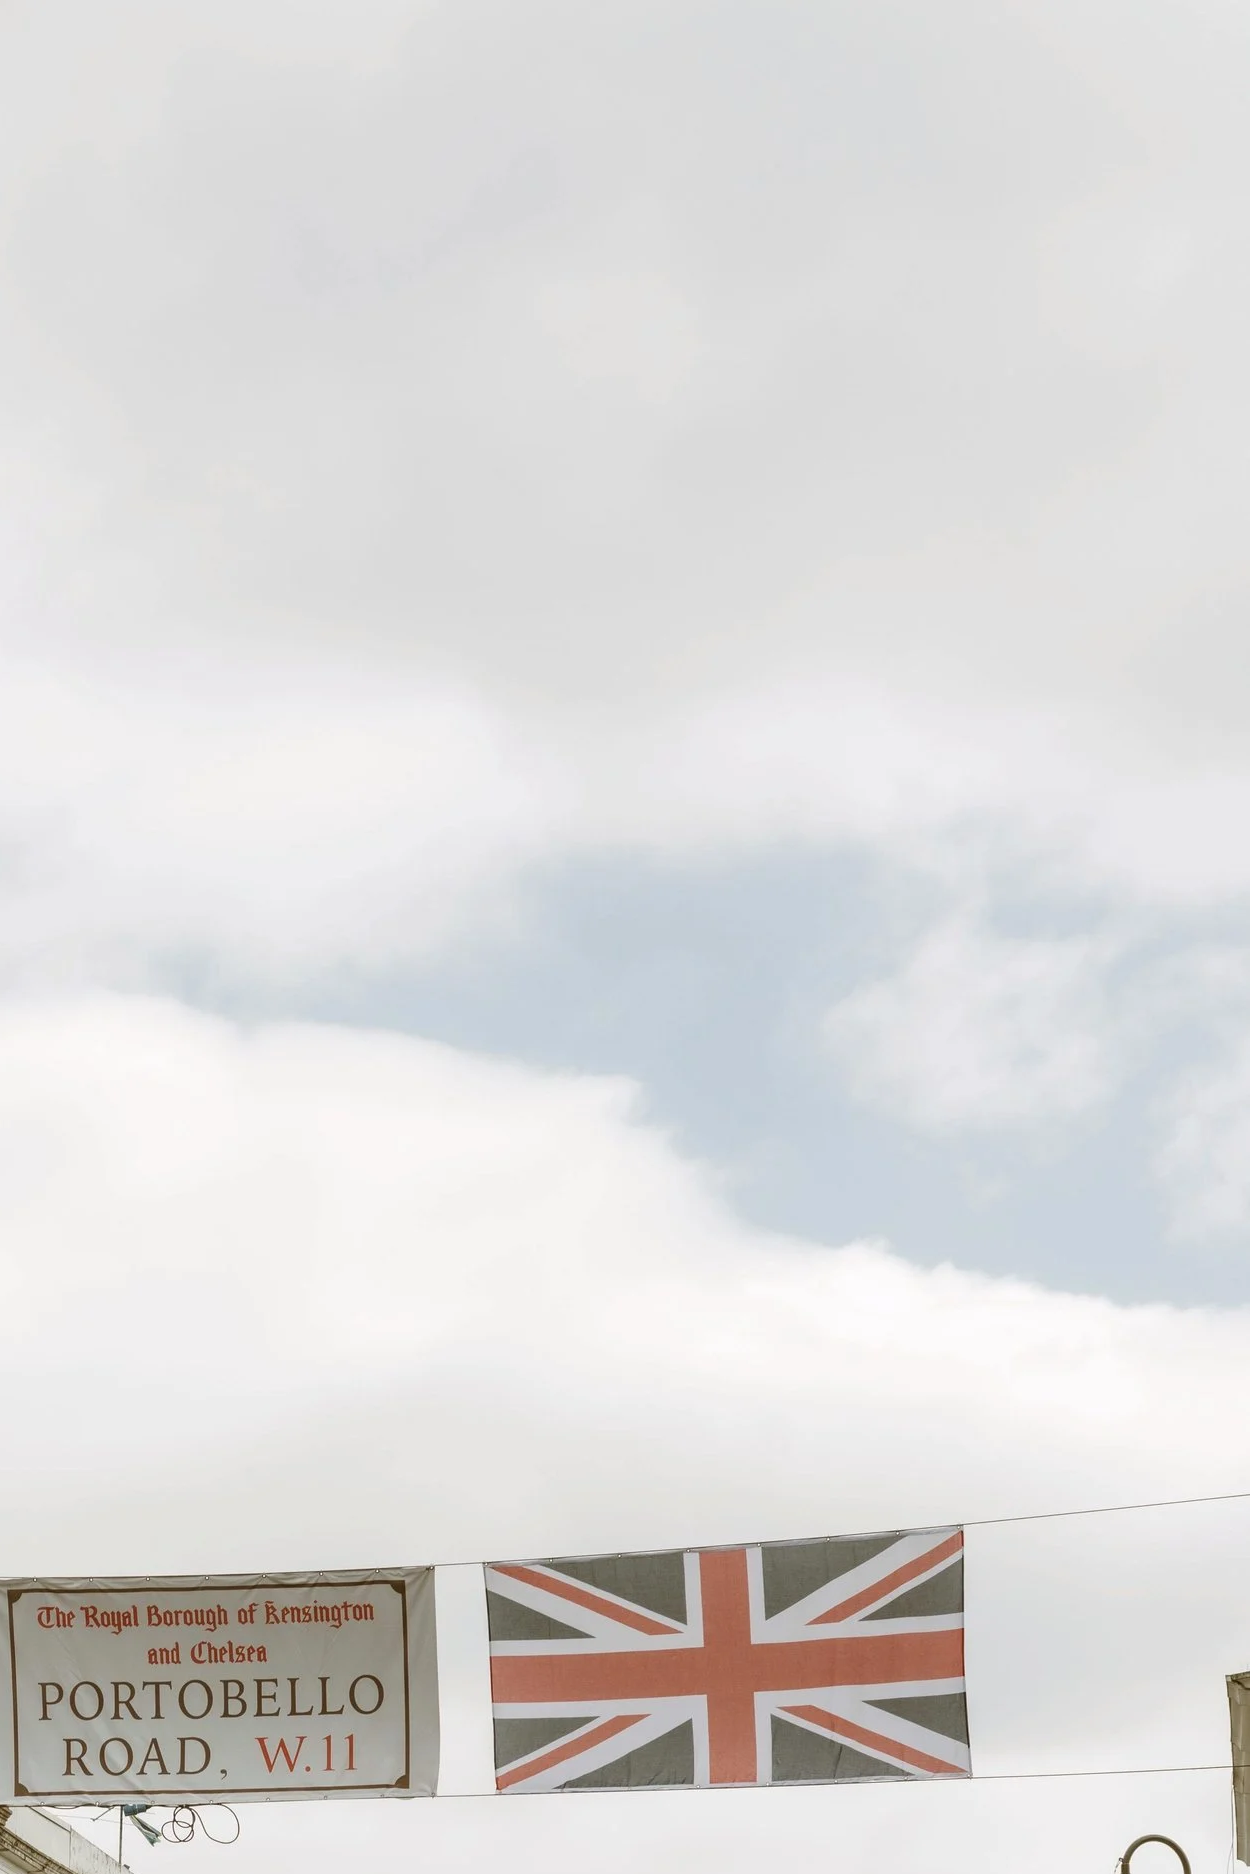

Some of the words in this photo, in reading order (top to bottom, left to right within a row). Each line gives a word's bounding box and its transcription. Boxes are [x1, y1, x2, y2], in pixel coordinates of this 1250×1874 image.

[37, 1606, 75, 1629] The
[80, 1604, 138, 1635] Royal
[147, 1604, 229, 1632] Borough
[237, 1602, 258, 1625] of
[265, 1600, 374, 1631] Kensington
[147, 1642, 181, 1665] and
[190, 1641, 268, 1665] Chelsea
[37, 1674, 385, 1721] PORTOBELLO
[62, 1736, 229, 1780] ROAD,
[255, 1733, 358, 1774] W.11
